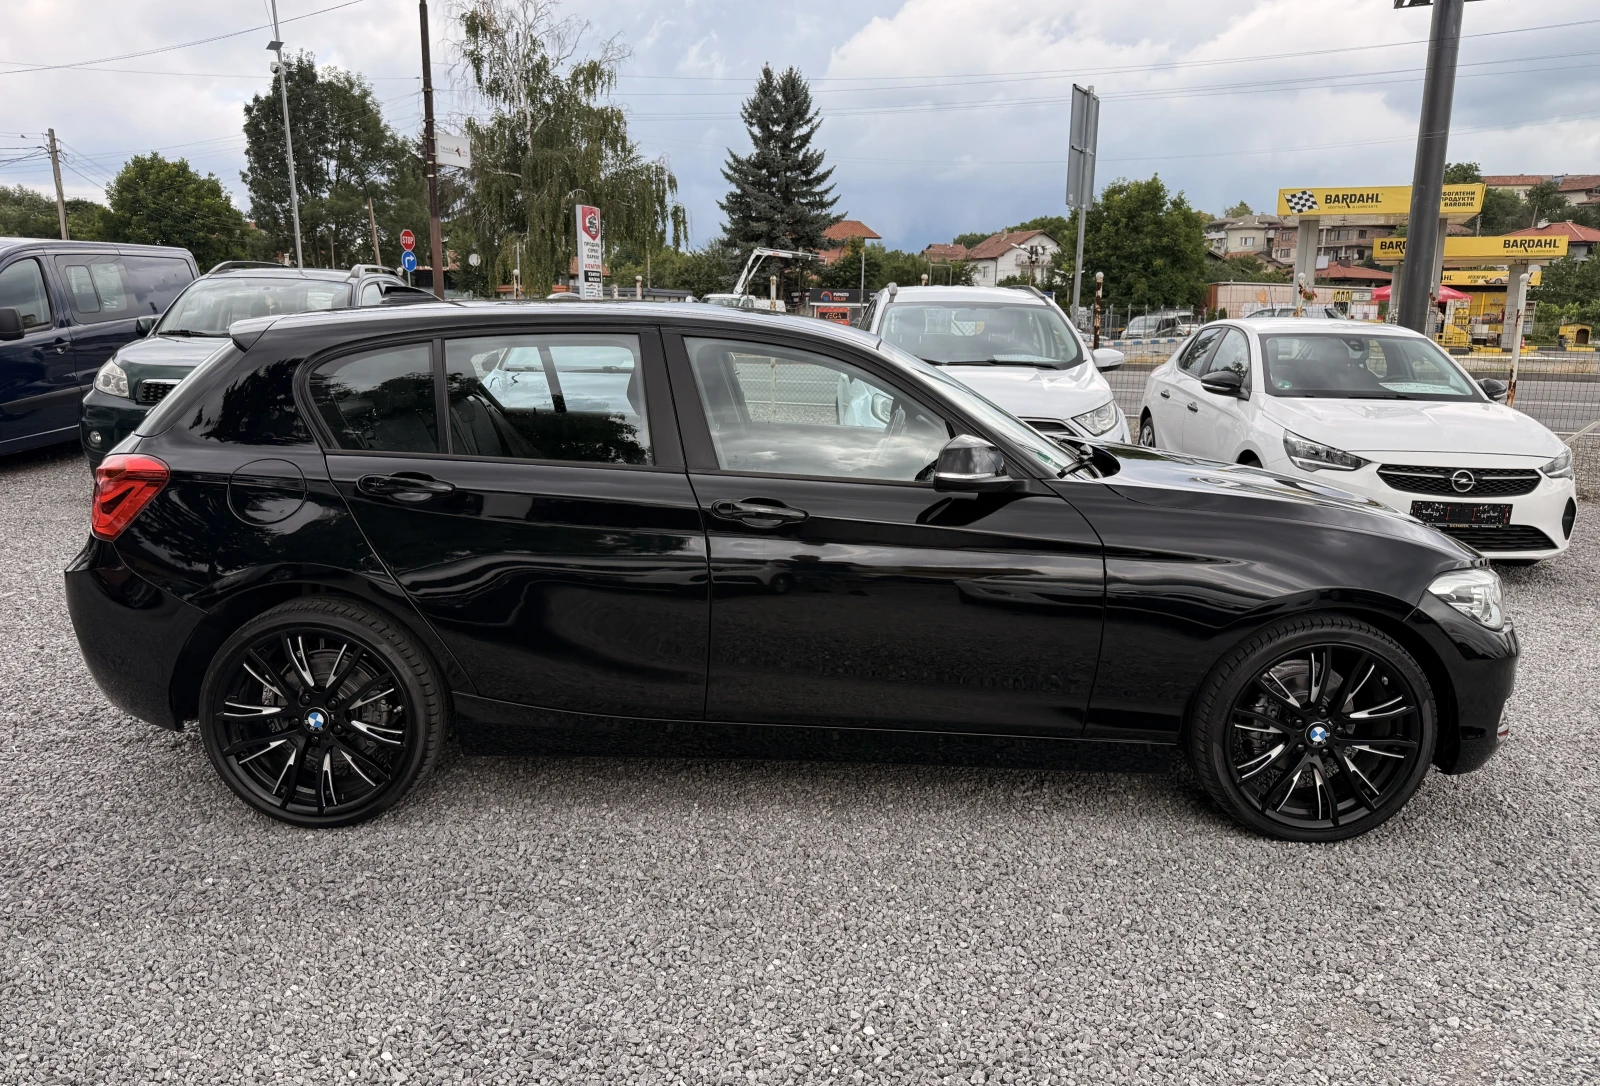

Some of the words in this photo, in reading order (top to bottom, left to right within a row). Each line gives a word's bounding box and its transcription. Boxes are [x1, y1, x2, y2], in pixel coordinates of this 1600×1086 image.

[1324, 193, 1382, 209] BARDAHL
[402, 235, 414, 245] STOP
[1503, 239, 1560, 253] BARDAHL
